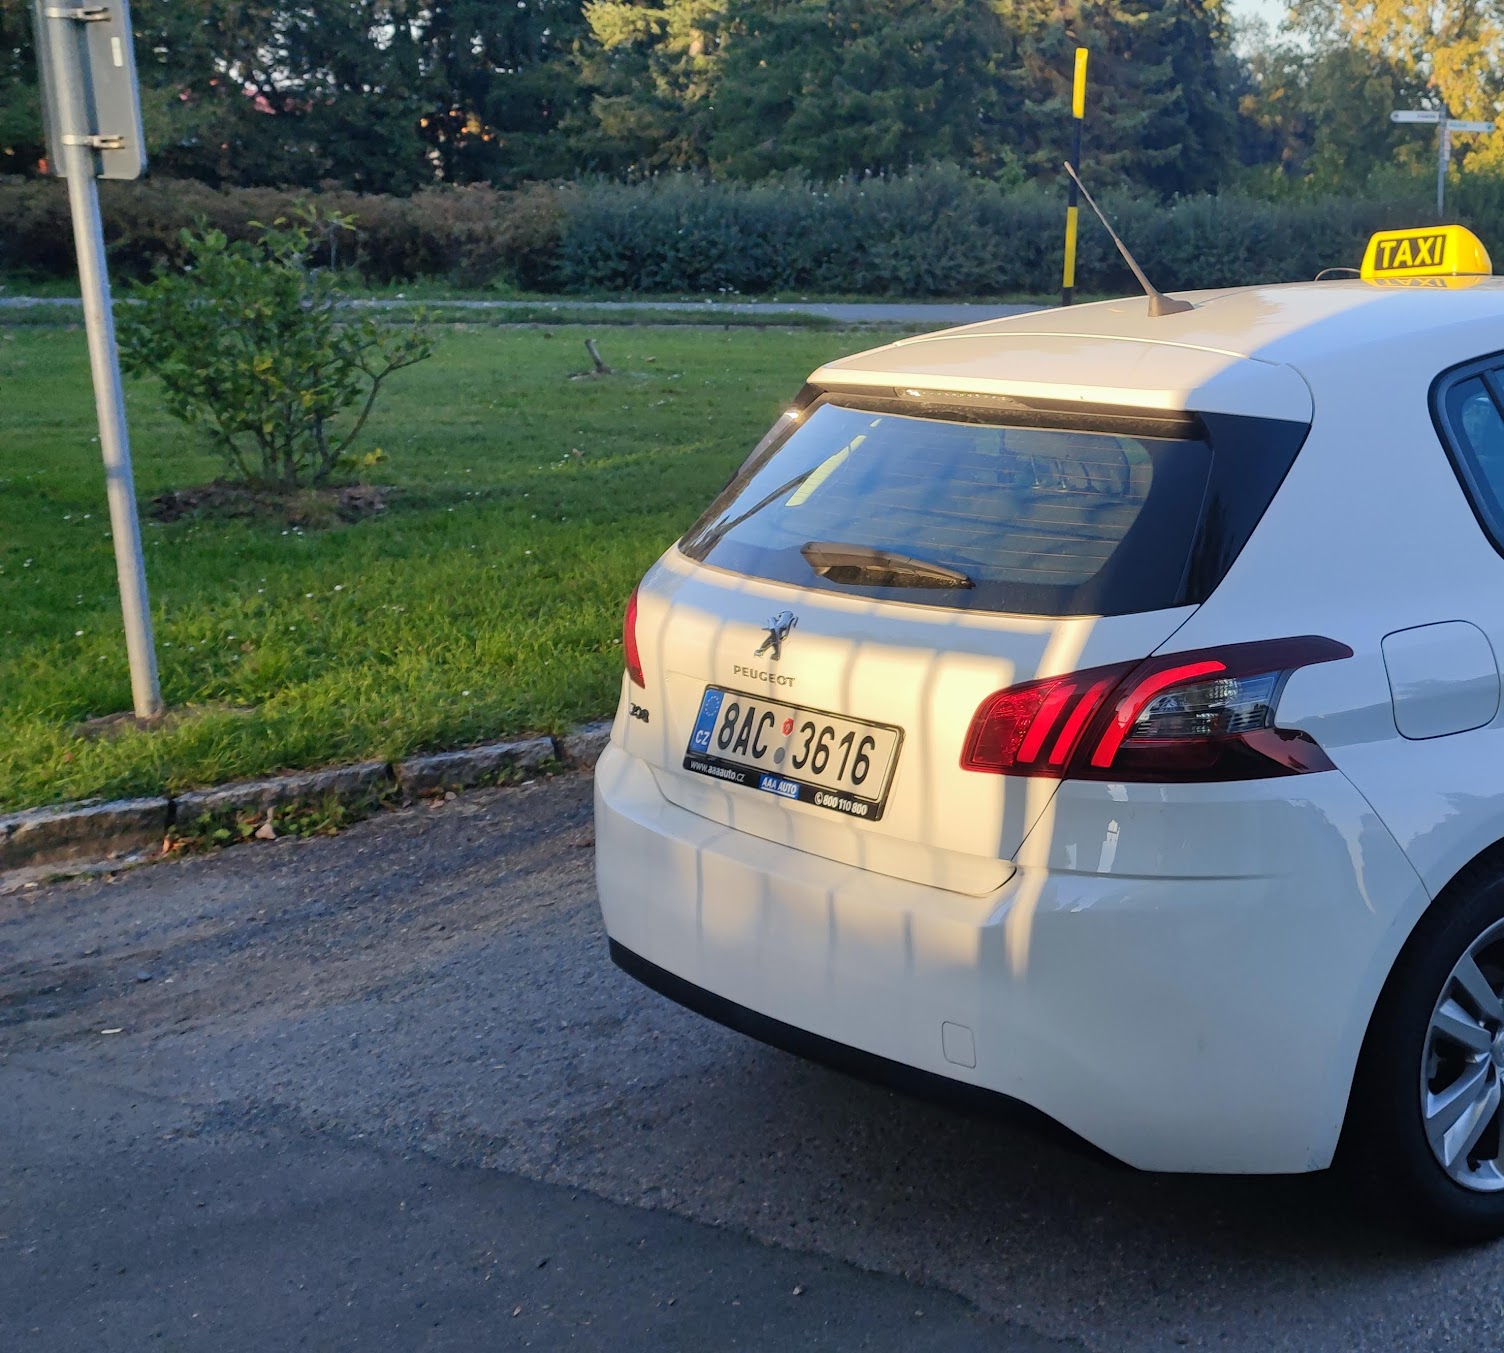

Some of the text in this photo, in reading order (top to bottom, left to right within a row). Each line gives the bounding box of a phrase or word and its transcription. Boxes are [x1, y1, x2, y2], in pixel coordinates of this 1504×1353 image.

[1380, 236, 1443, 268] TAXI
[733, 665, 796, 687] PEUGEOT
[695, 729, 710, 747] CZ
[717, 702, 876, 786] 8AC 3616
[690, 760, 746, 783] www.aaaauto.cz
[761, 776, 798, 796] AAA AUTO
[822, 795, 868, 817] 800 110 800
